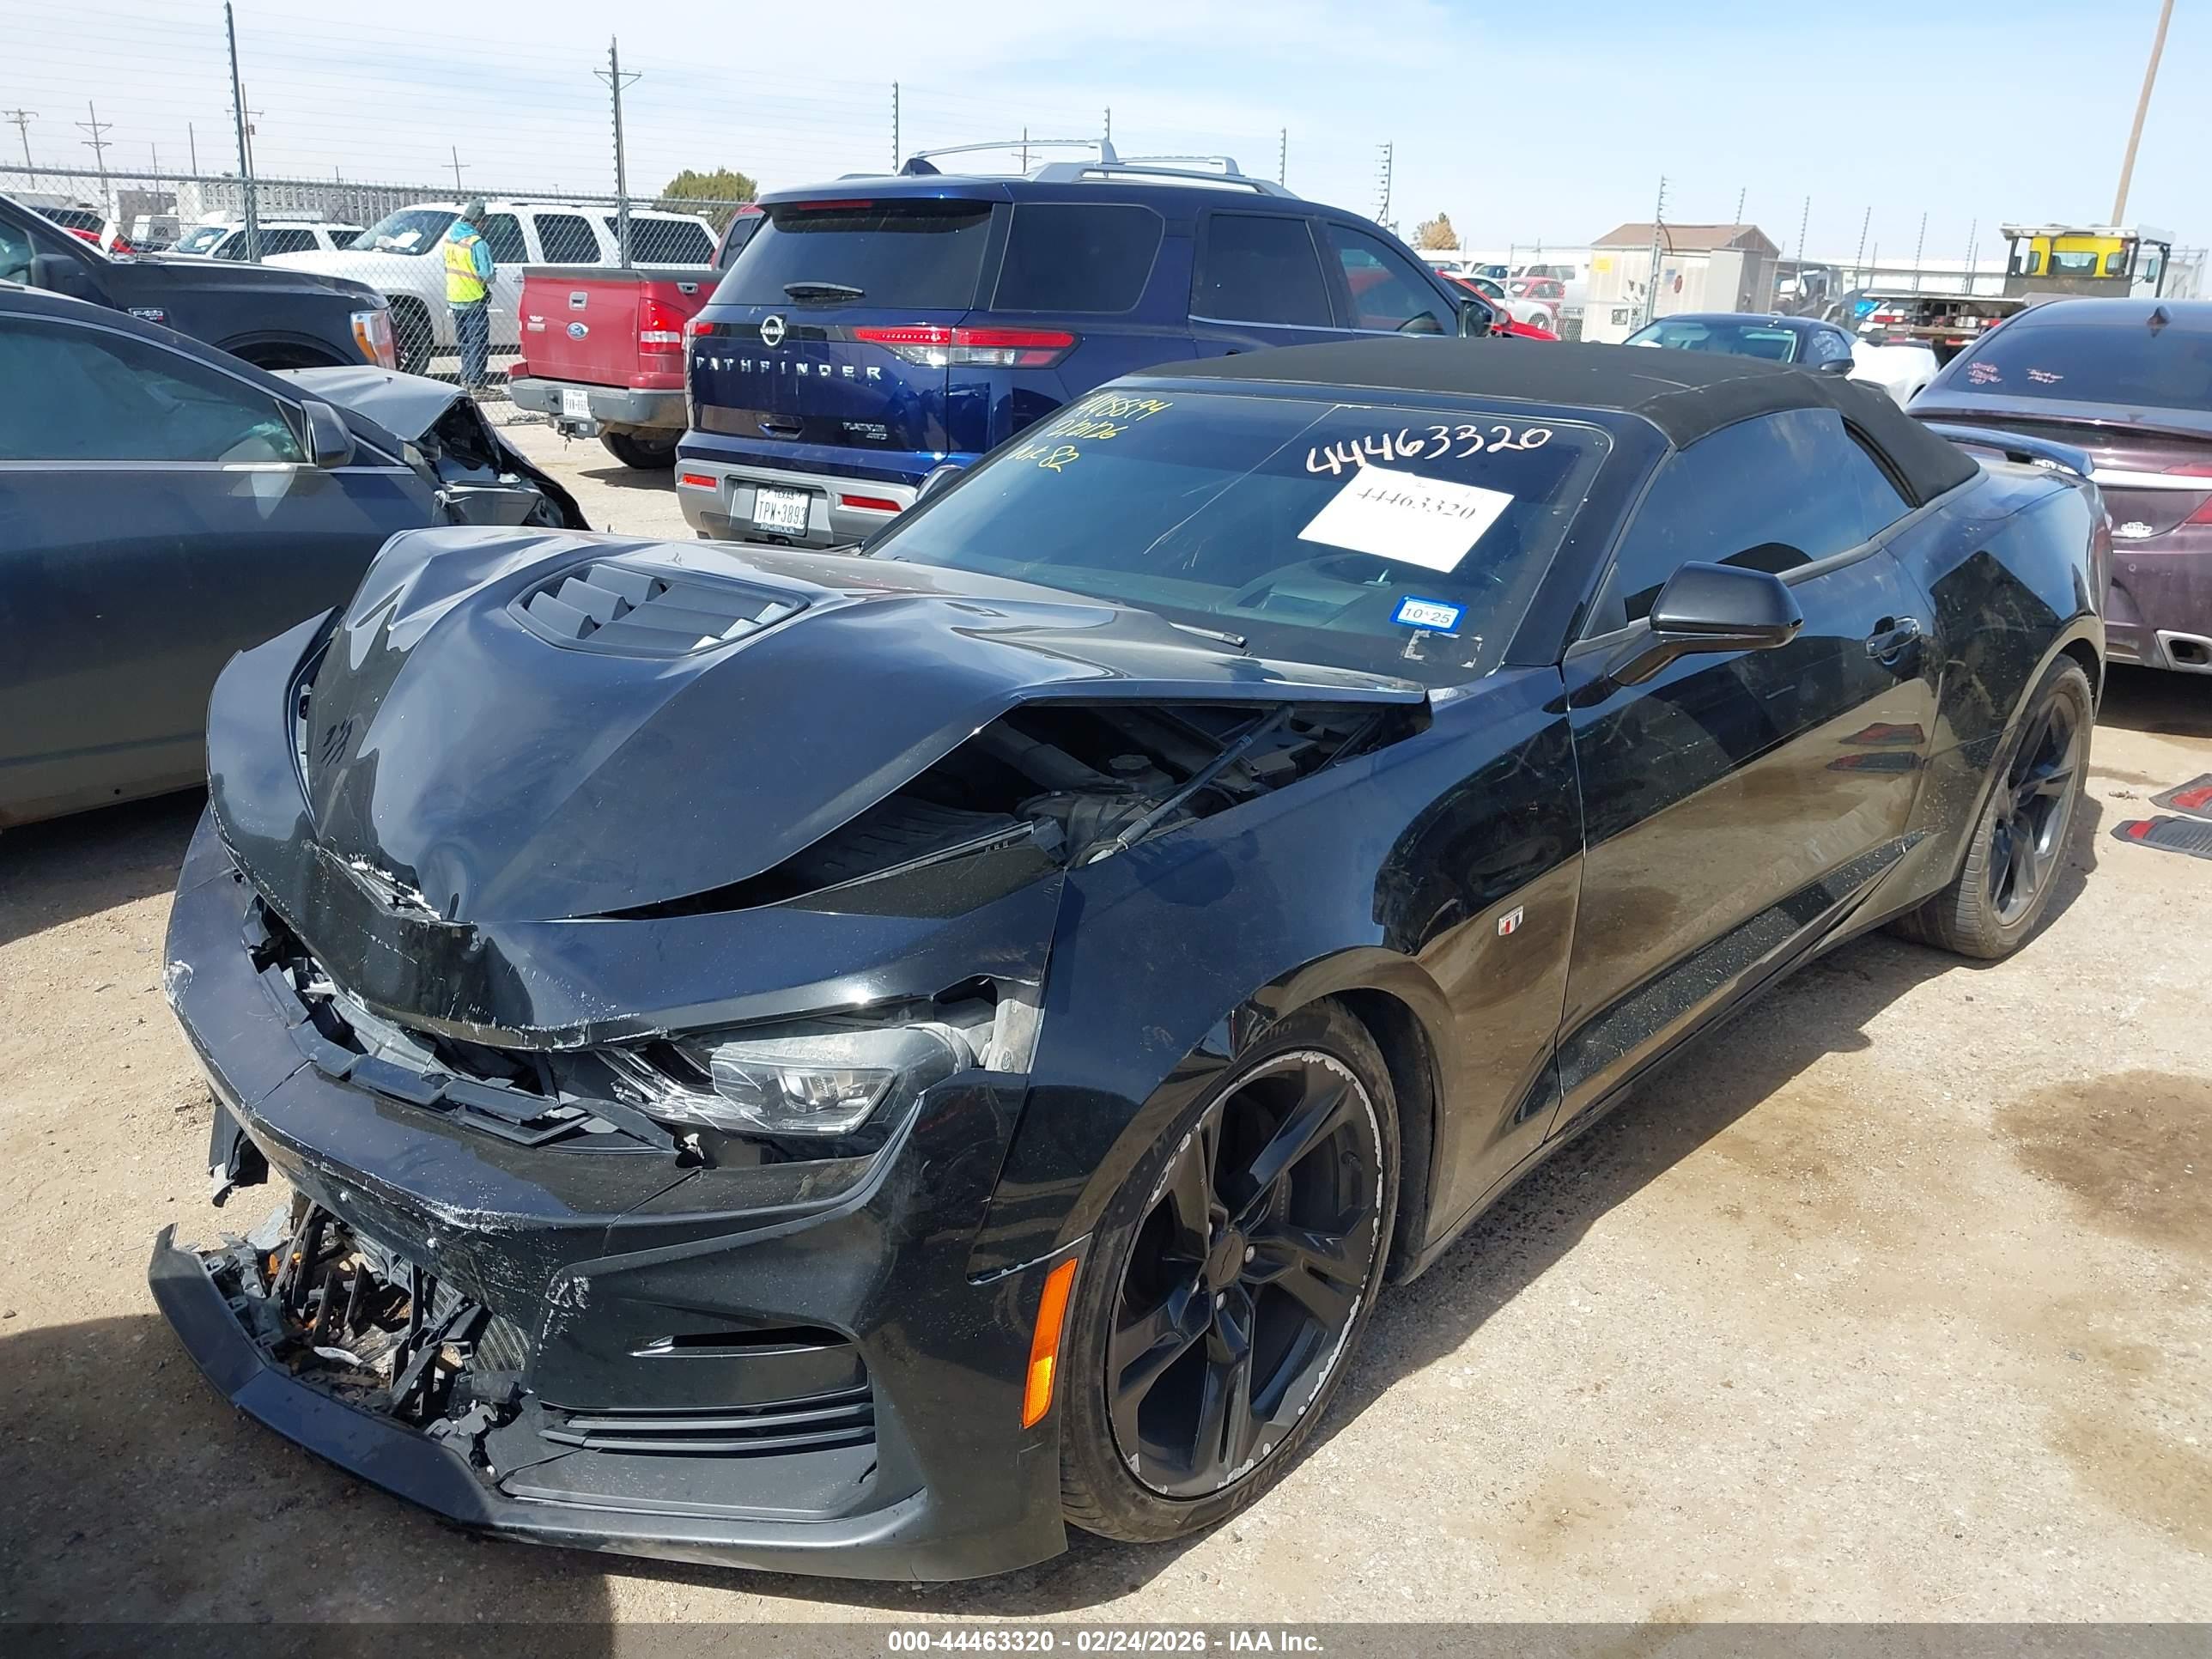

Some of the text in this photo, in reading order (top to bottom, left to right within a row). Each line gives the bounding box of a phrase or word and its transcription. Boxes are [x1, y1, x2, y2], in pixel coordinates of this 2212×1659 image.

[760, 327, 786, 336] NISSAN
[696, 356, 882, 380] PATHFINDER
[1305, 424, 1553, 476] 44463320
[1357, 487, 1477, 520] 44463320
[1405, 608, 1452, 624] 10 25
